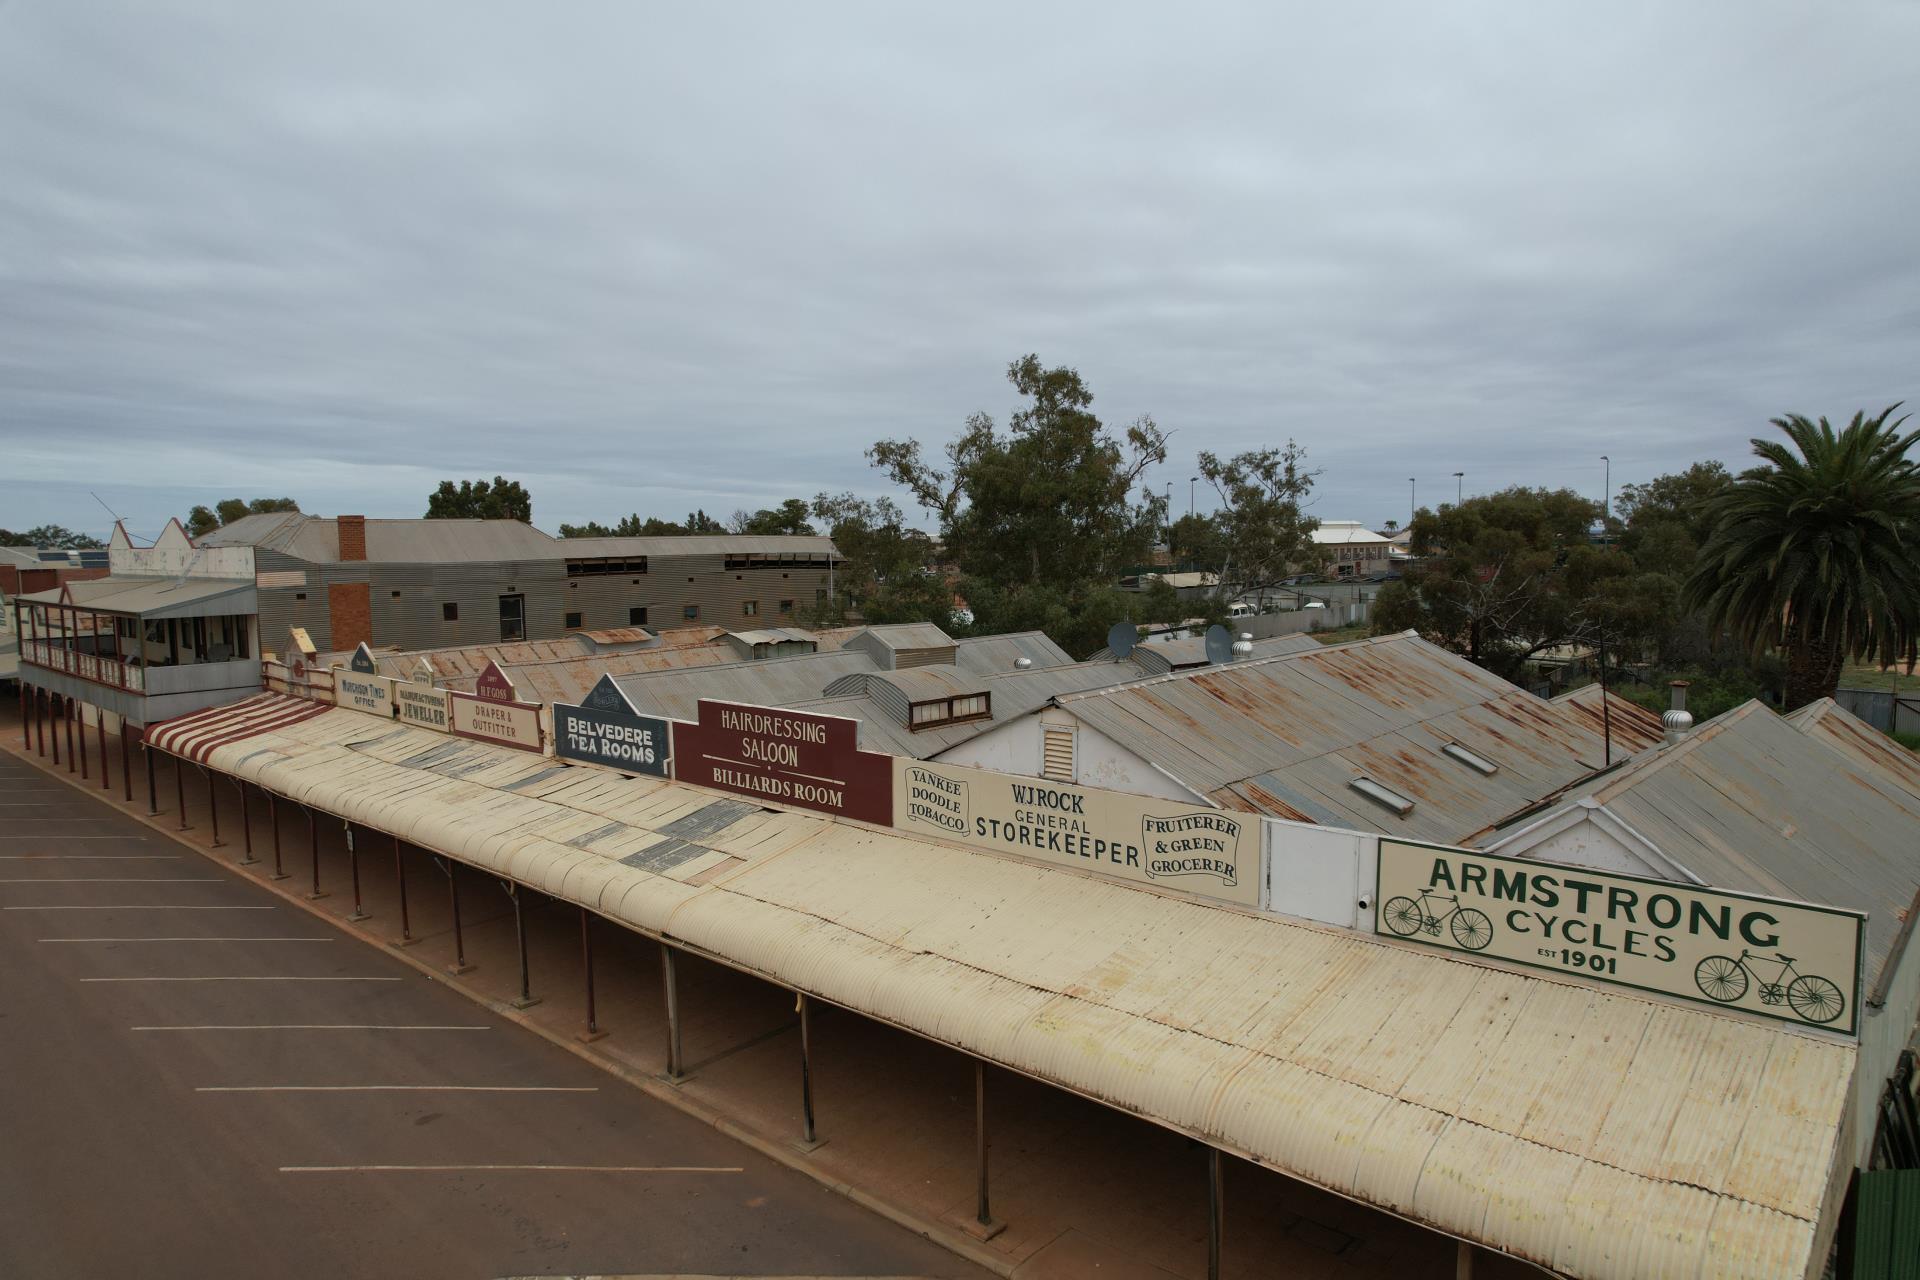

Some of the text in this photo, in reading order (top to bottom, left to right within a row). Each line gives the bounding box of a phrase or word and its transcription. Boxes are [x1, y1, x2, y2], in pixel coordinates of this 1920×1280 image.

[404, 702, 446, 726] JEWELLER
[472, 718, 516, 737] OUTFITTER
[475, 705, 512, 723] DRAPER &
[721, 710, 826, 745] HAIRDRESSING
[567, 716, 653, 747] BELVEDERE
[568, 733, 655, 764] TEA ROOMS
[742, 738, 798, 768] SALOON
[713, 767, 843, 808] BILLIARDS ROOM
[912, 770, 962, 797] YANKEE
[912, 787, 961, 814] DOODLE
[909, 802, 965, 831] TOBACCO
[1015, 809, 1091, 835] GENERAL
[1145, 816, 1237, 838] FRUITERER
[975, 817, 1139, 868] STOREKEEPER
[1155, 837, 1225, 855] & GREEN
[1151, 858, 1235, 879] GROCERER
[1429, 858, 1782, 948] ARMSTRONG
[1506, 909, 1677, 963] CYCLES
[1537, 947, 1617, 975] EST 1901
